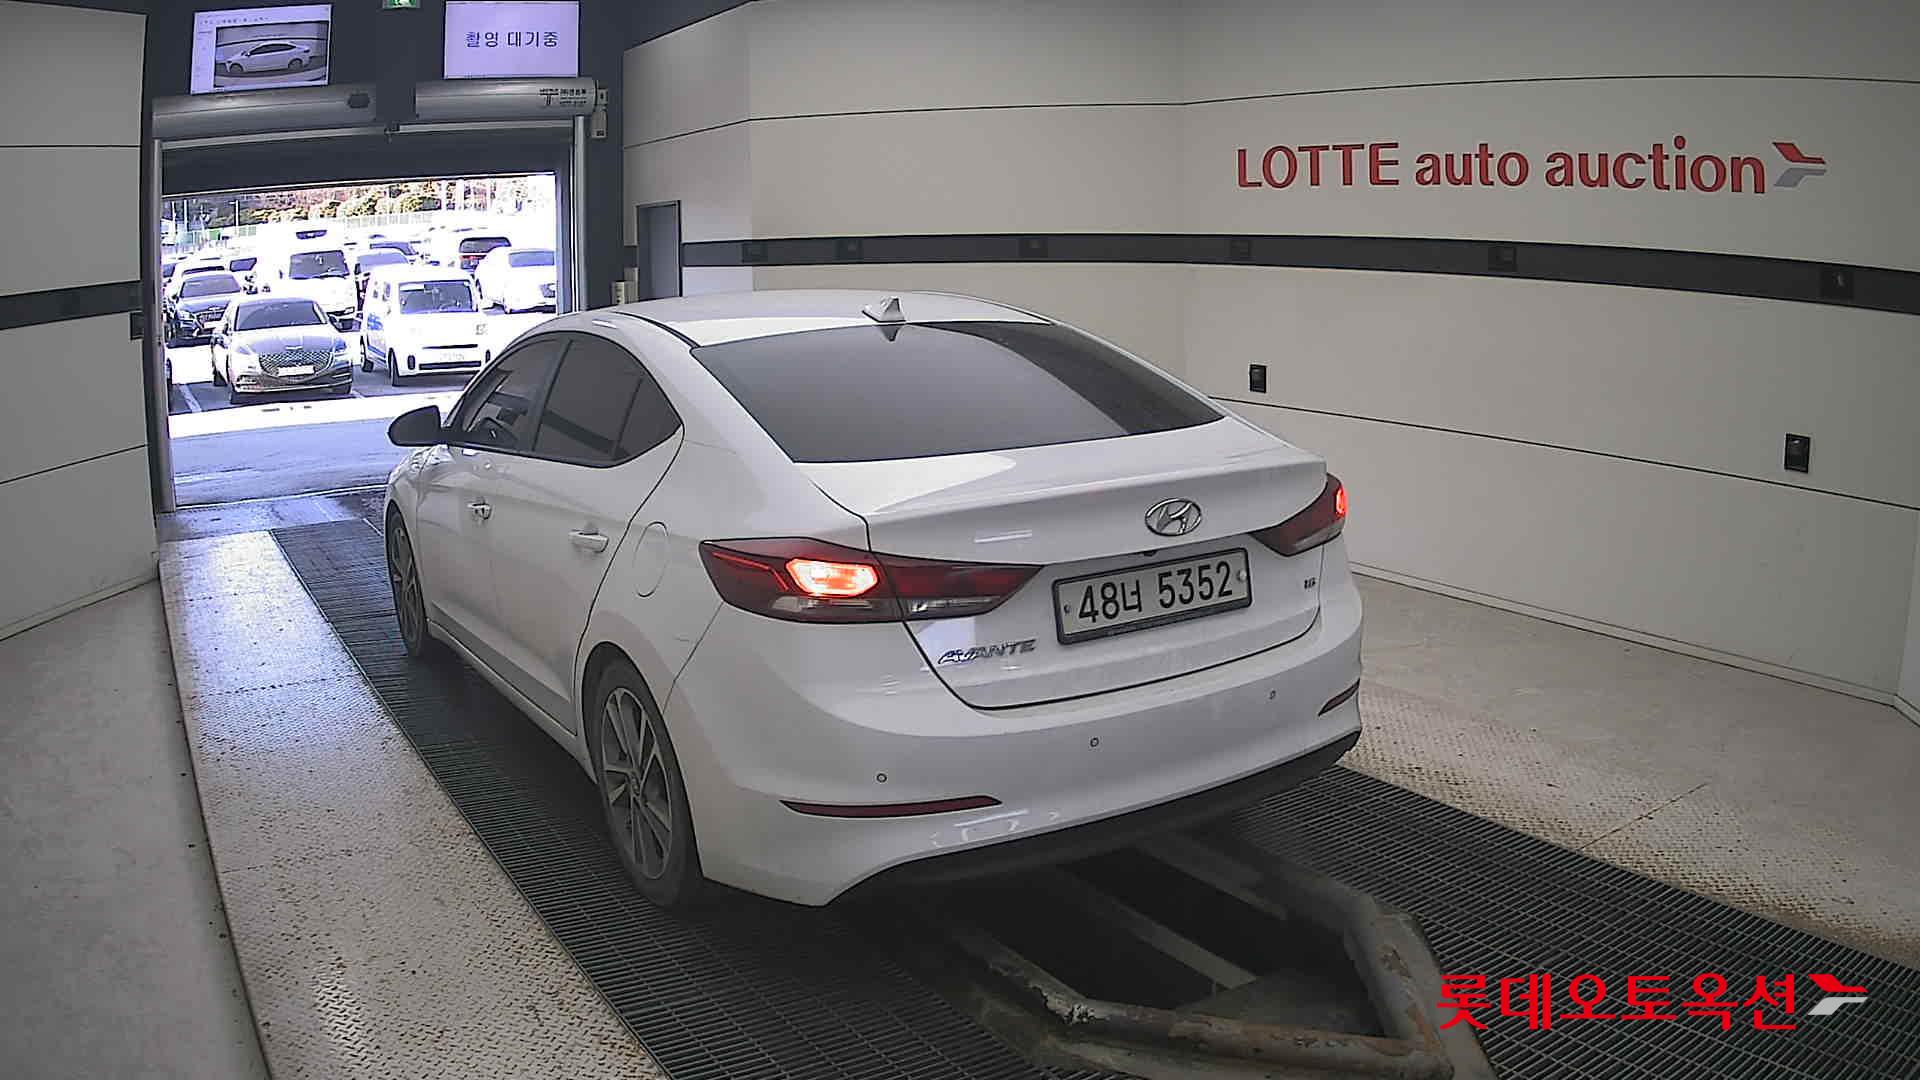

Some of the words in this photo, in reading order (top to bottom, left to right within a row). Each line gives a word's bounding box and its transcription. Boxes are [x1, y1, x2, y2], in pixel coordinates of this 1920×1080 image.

[466, 31, 499, 48] 촬영
[507, 31, 559, 48] 대기중
[1237, 143, 1399, 188] LOTTE
[1415, 145, 1528, 187] auto
[1546, 137, 1765, 193] auction
[1078, 579, 1143, 623] 48너
[1157, 560, 1234, 609] 5352
[937, 638, 1037, 665] AVANTE
